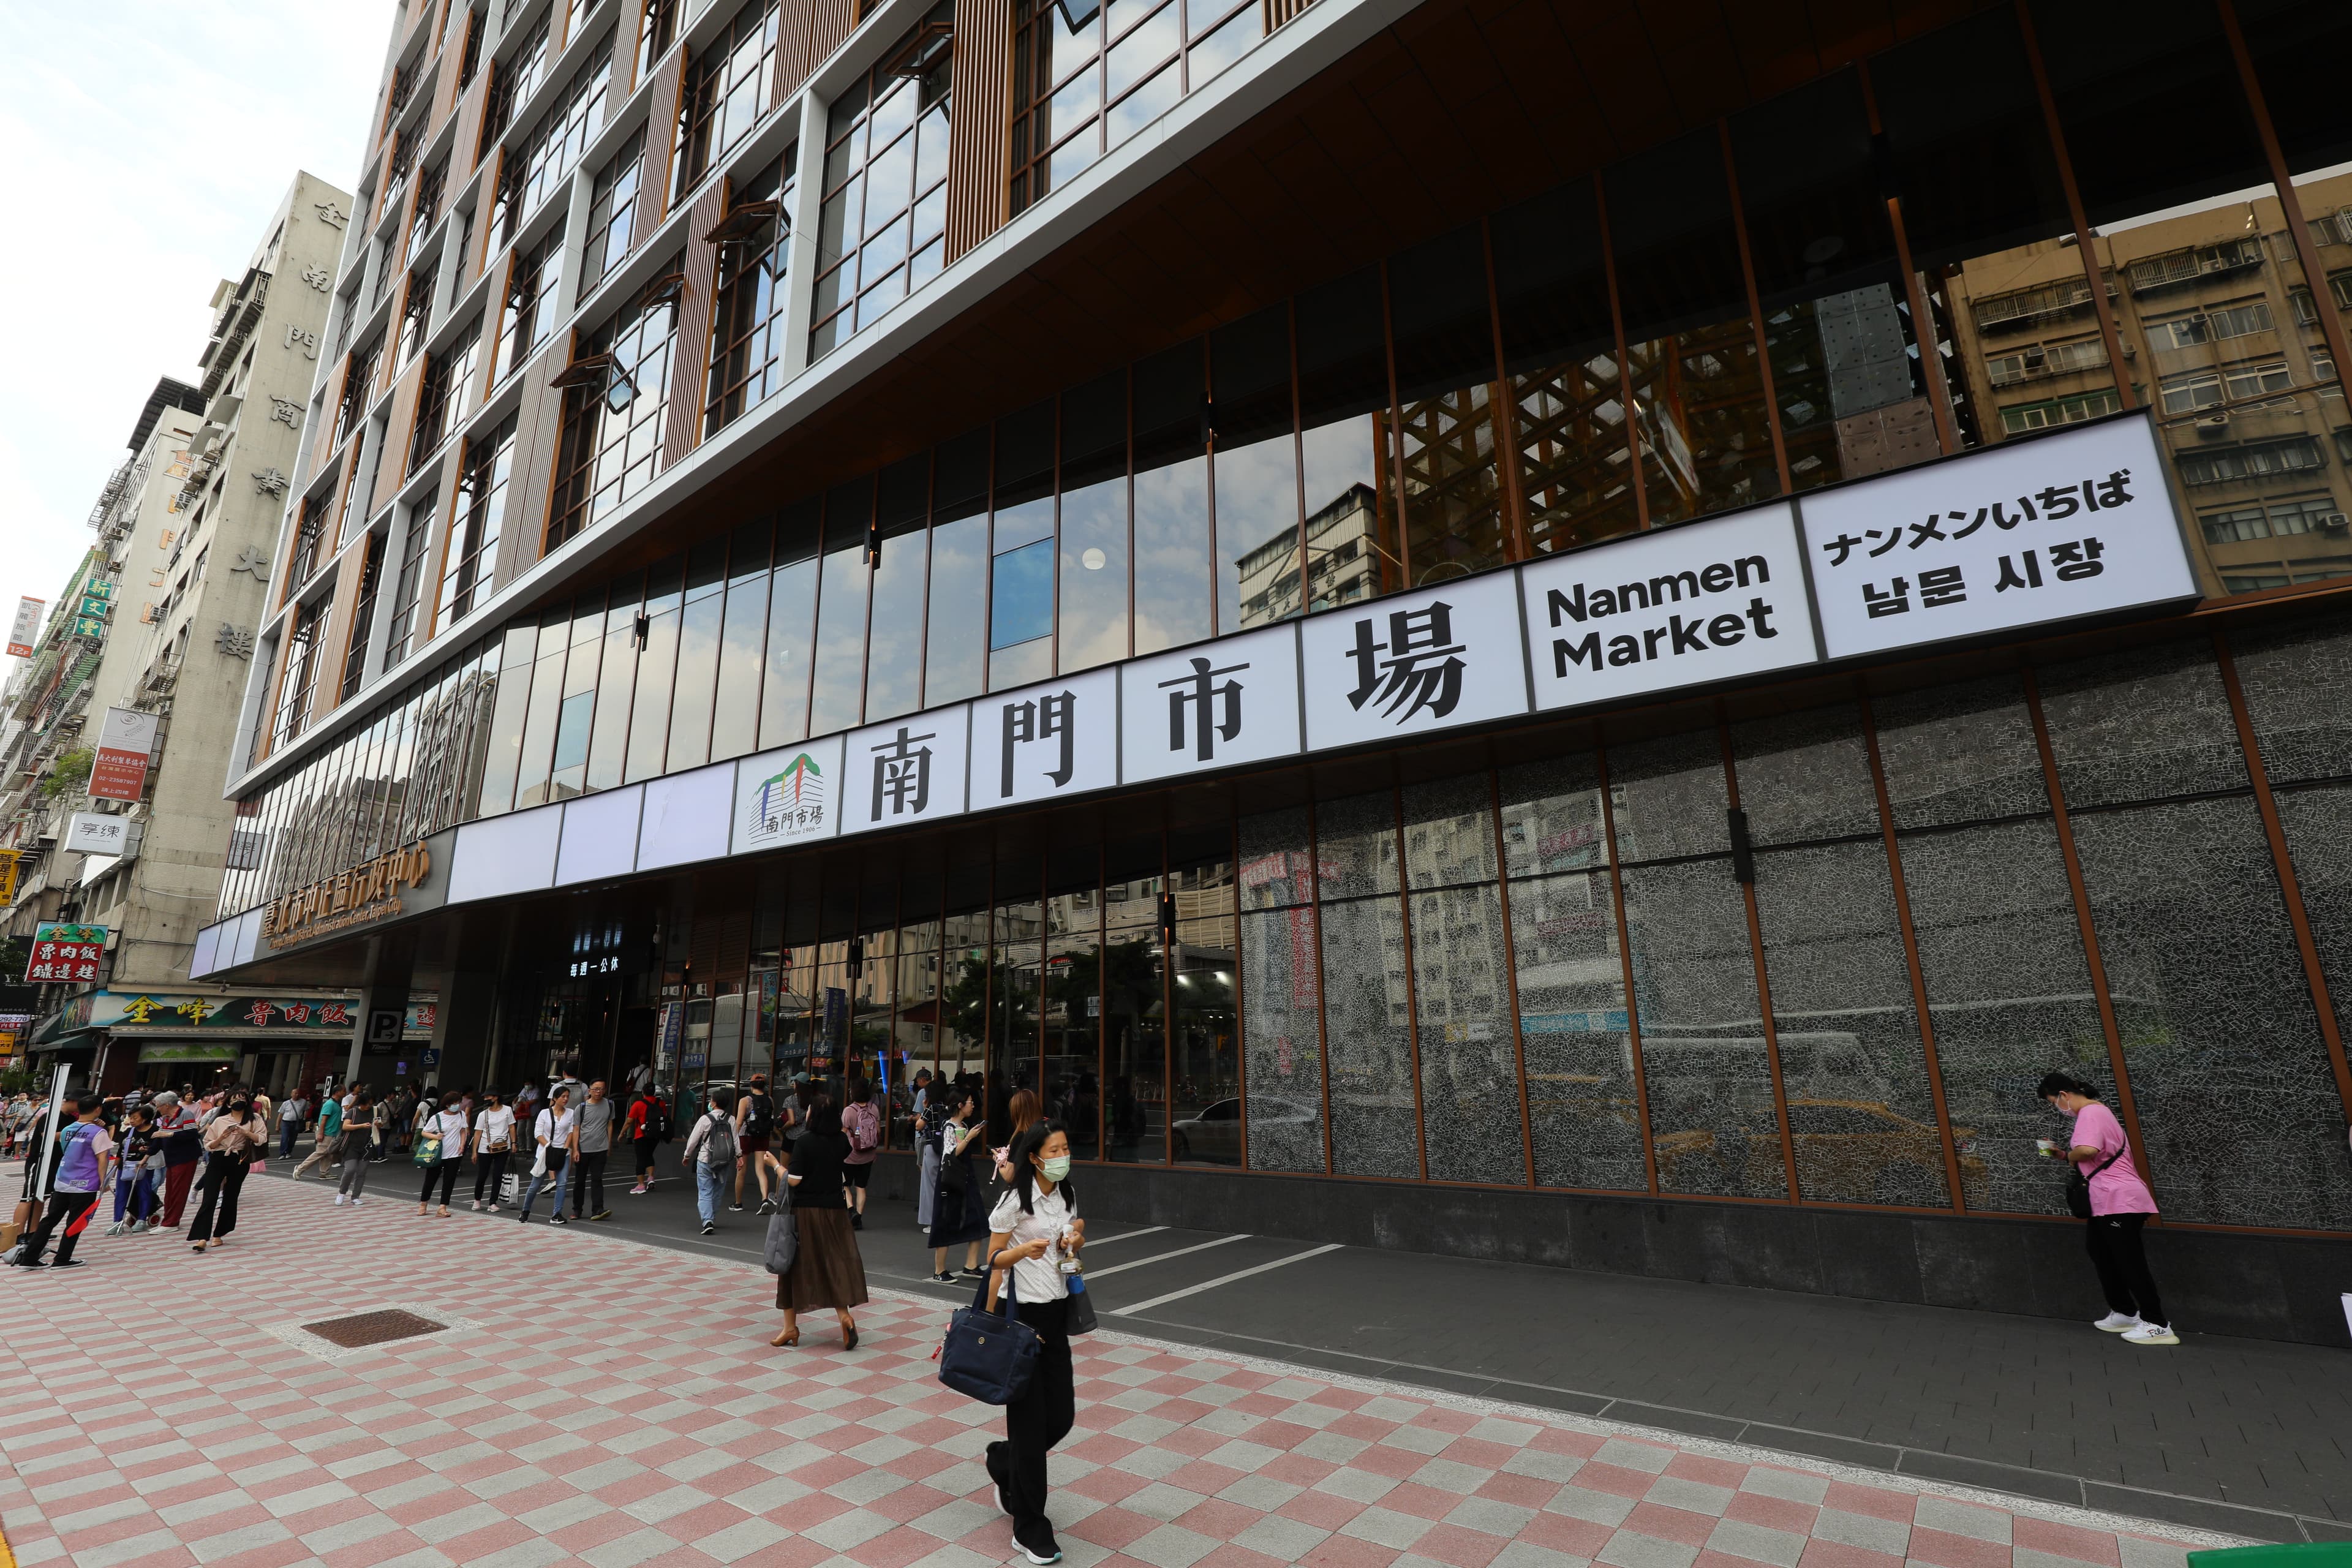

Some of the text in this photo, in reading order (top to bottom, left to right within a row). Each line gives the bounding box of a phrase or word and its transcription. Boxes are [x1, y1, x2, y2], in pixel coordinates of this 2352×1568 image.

[1823, 468, 2135, 567] ナンメンいちば
[1547, 554, 1771, 628] Nanmen
[1861, 537, 2105, 619] 남문 시장
[80, 580, 110, 636] 新文豐
[10, 646, 31, 656] 12F
[1552, 597, 1779, 679] Market
[870, 601, 1467, 823] 南門市場
[766, 805, 824, 833] 南門市場
[262, 840, 429, 939] 臺北市中正區行政中心
[49, 925, 96, 942] 金峰
[39, 943, 99, 960] 魯肉飯
[570, 956, 619, 978] 每週一公休
[123, 995, 215, 1027] 金峰
[244, 999, 349, 1027] 魯肉飯
[373, 1014, 398, 1039] P
[325, 1077, 331, 1096] P
[2146, 1327, 2166, 1338] Fila
